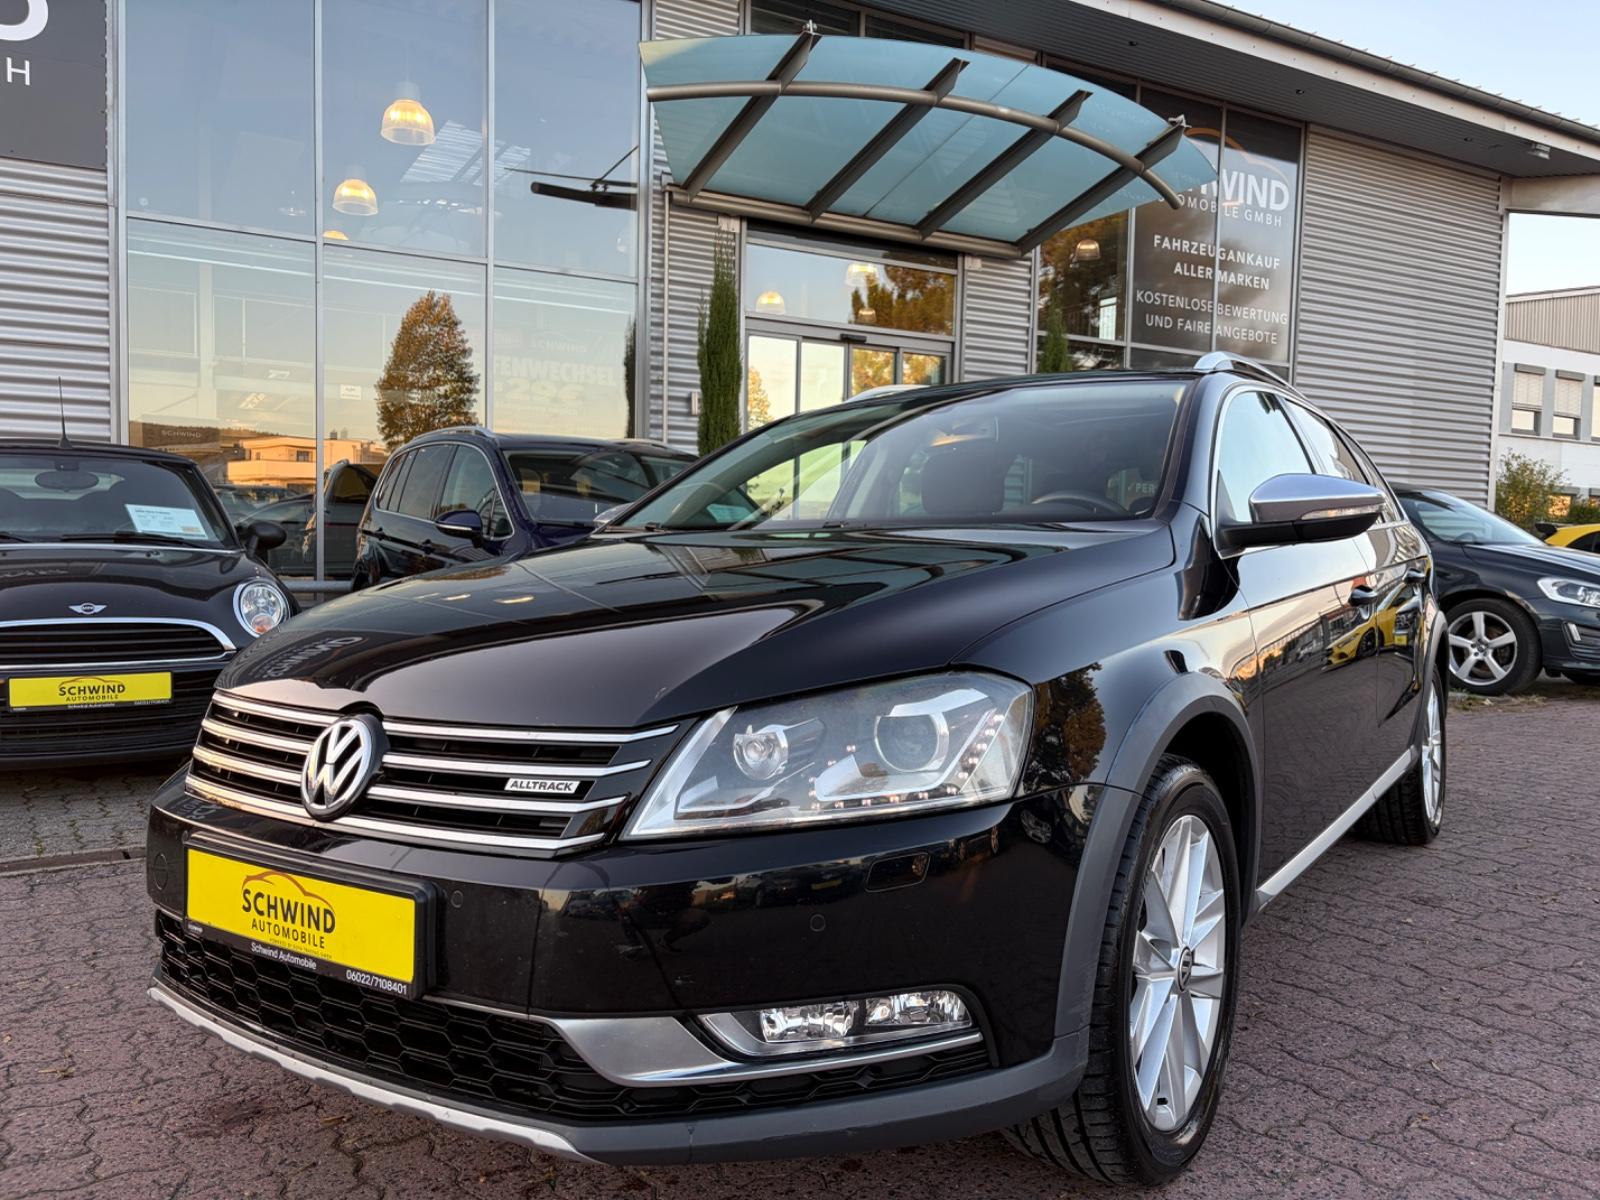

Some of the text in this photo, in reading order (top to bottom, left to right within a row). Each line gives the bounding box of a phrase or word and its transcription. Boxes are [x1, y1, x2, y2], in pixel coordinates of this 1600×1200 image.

[1244, 209, 1282, 227] GMBH
[1153, 234, 1281, 270] FAHRZEUGANKAUF
[1173, 262, 1270, 290] ALLER MARKEN
[1135, 289, 1288, 325] KOSTENLOSE BEWERTUNG
[1145, 313, 1278, 345] UND FAIRE ANGEBOTE
[58, 683, 126, 696] SCHWIND
[65, 694, 119, 702] AUTOMOBILE
[510, 780, 574, 791] ALLTRACK
[242, 888, 336, 934] SCHWIND
[251, 918, 325, 949] AUTOMOBILE
[251, 941, 317, 970] Schwind Automobile
[345, 969, 407, 995] 06022/7108401
